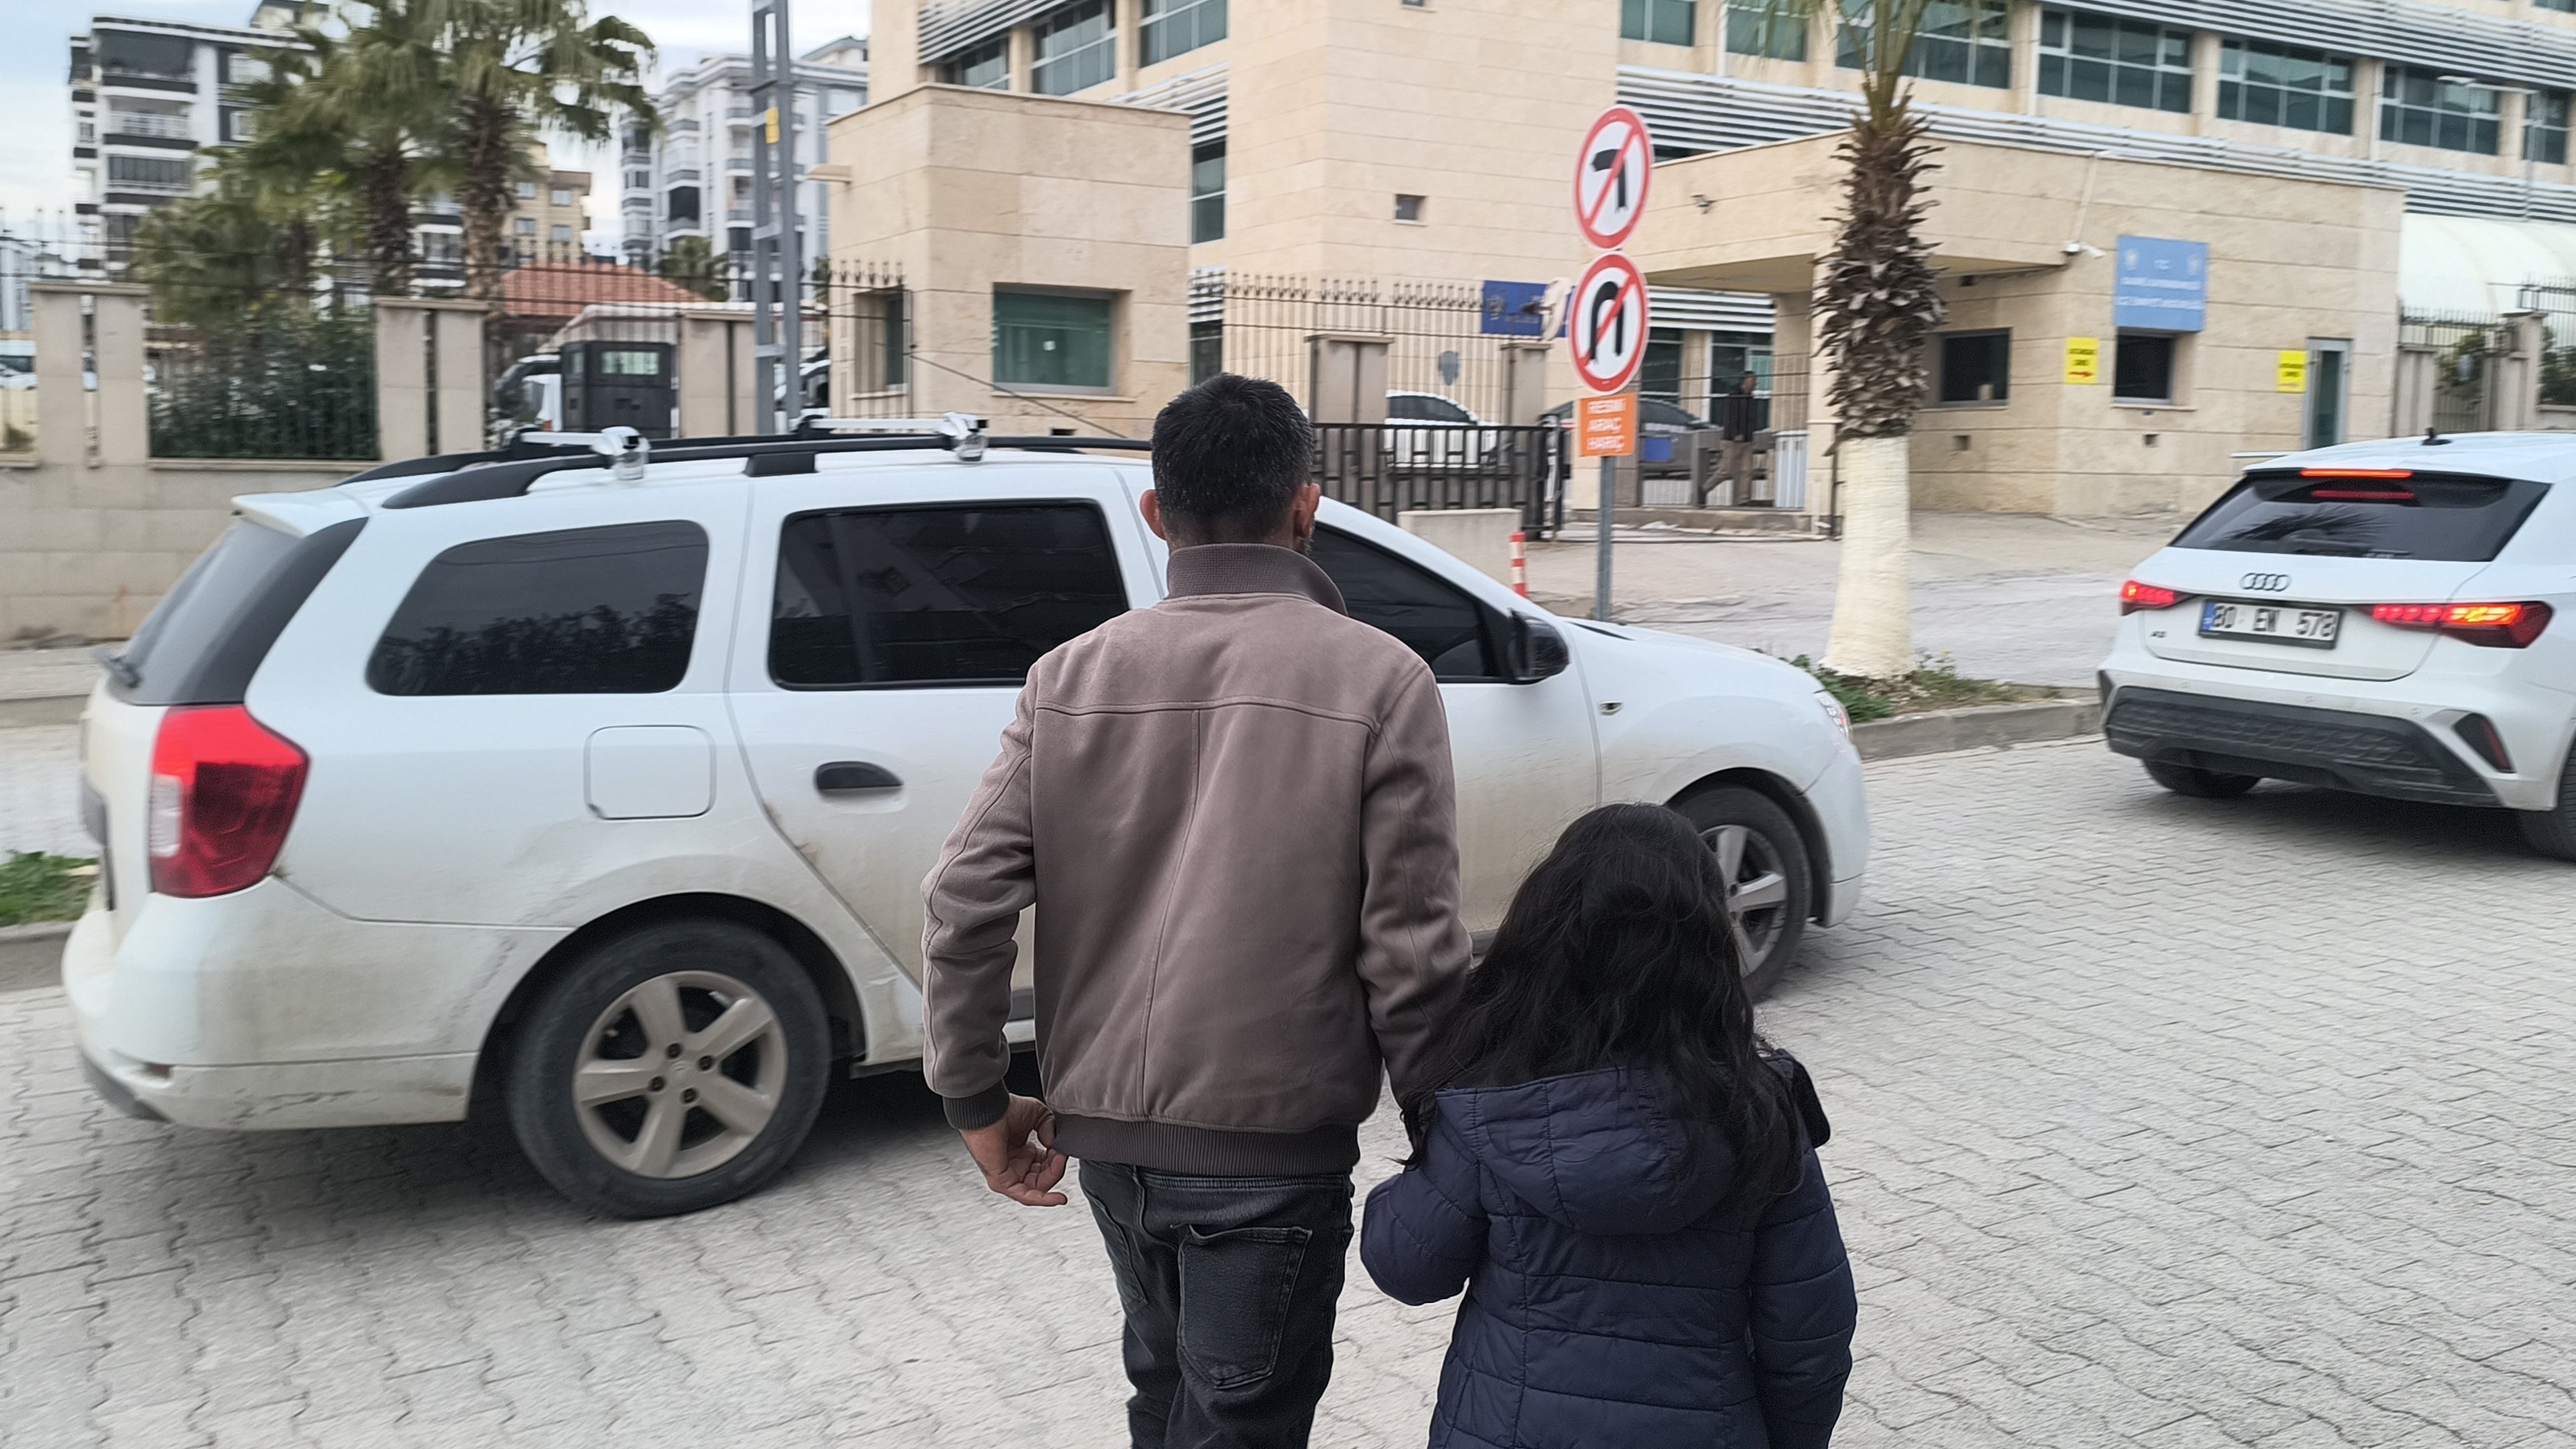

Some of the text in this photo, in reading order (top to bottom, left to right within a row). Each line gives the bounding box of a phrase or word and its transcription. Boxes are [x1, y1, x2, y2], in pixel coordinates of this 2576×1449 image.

[1587, 417, 1623, 434] ARAÇ
[2214, 606, 2237, 629] 80
[2296, 612, 2338, 637] 578
